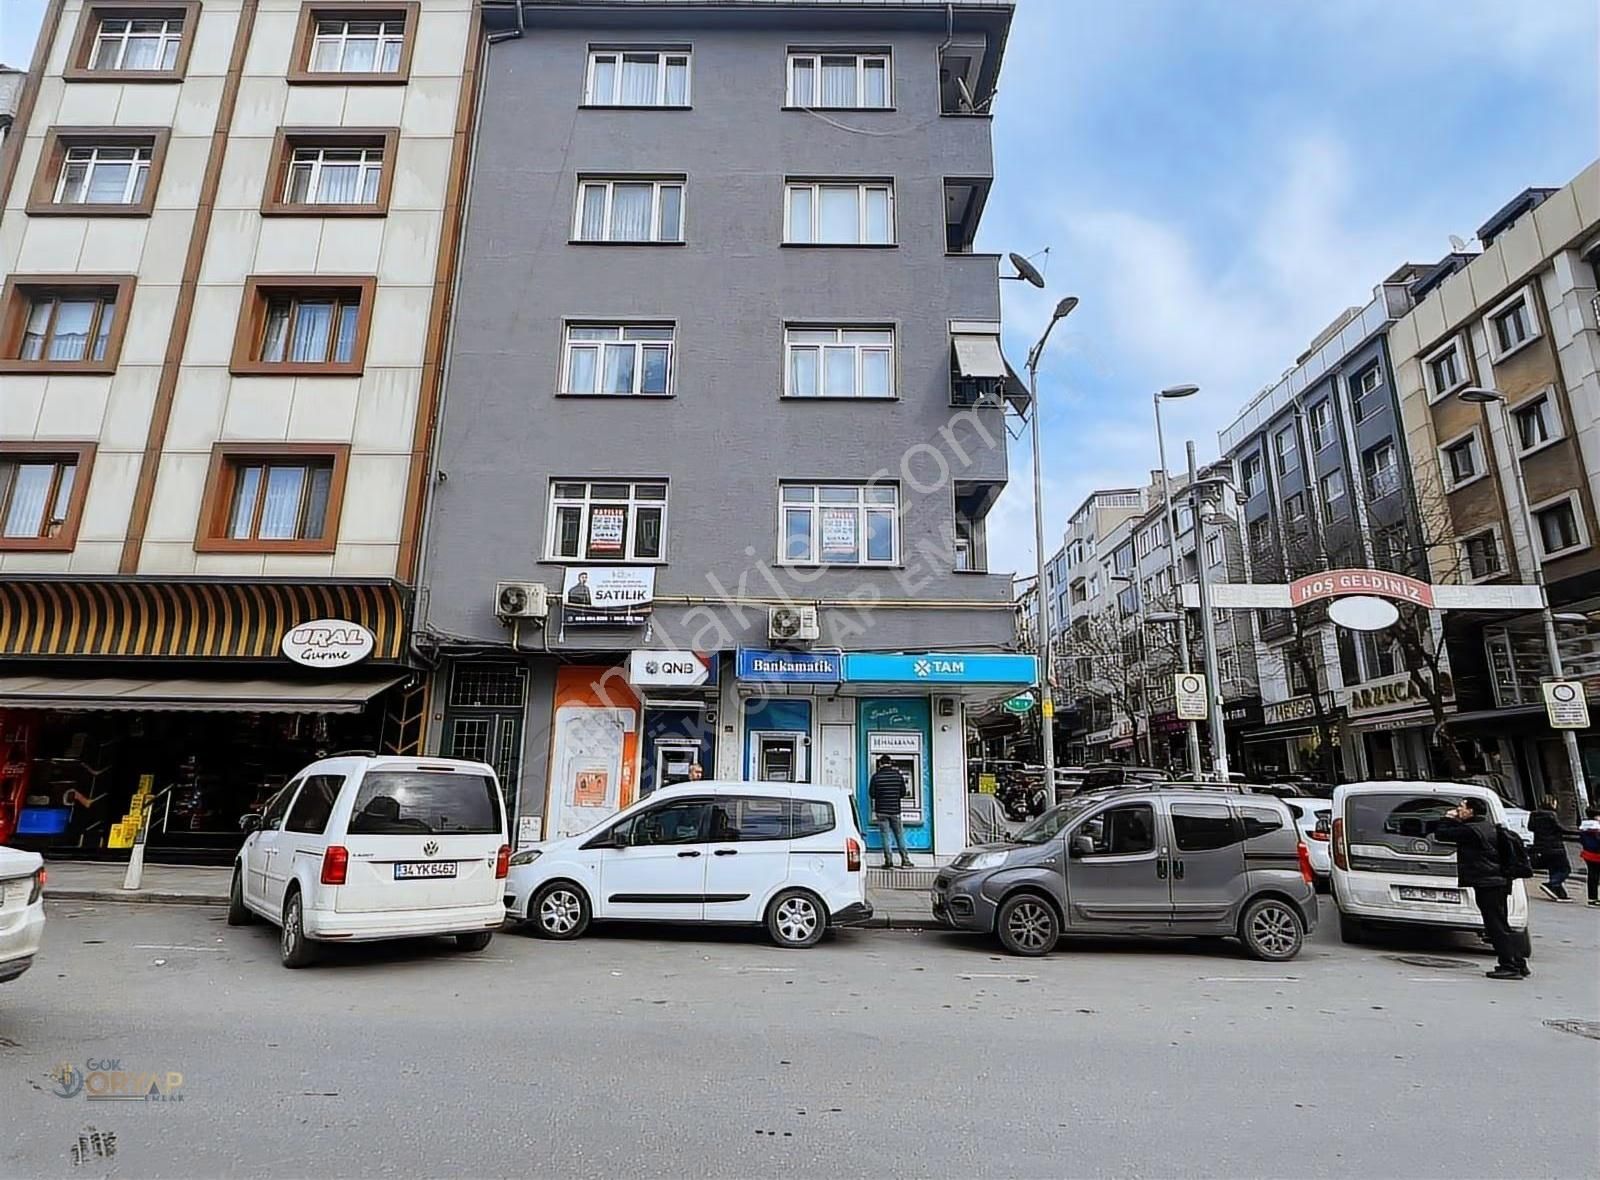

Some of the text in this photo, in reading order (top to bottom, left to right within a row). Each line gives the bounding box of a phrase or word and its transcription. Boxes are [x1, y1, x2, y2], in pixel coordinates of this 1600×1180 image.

[1301, 575, 1421, 600] HOŞ GELDİNİZ
[595, 589, 647, 600] SATILIK
[292, 629, 364, 648] URAL
[301, 648, 350, 660] Gurme
[662, 662, 694, 675] QNB
[753, 659, 833, 673] Bankamatik
[933, 660, 964, 673] TAM
[402, 863, 456, 875] 34 YK 6462
